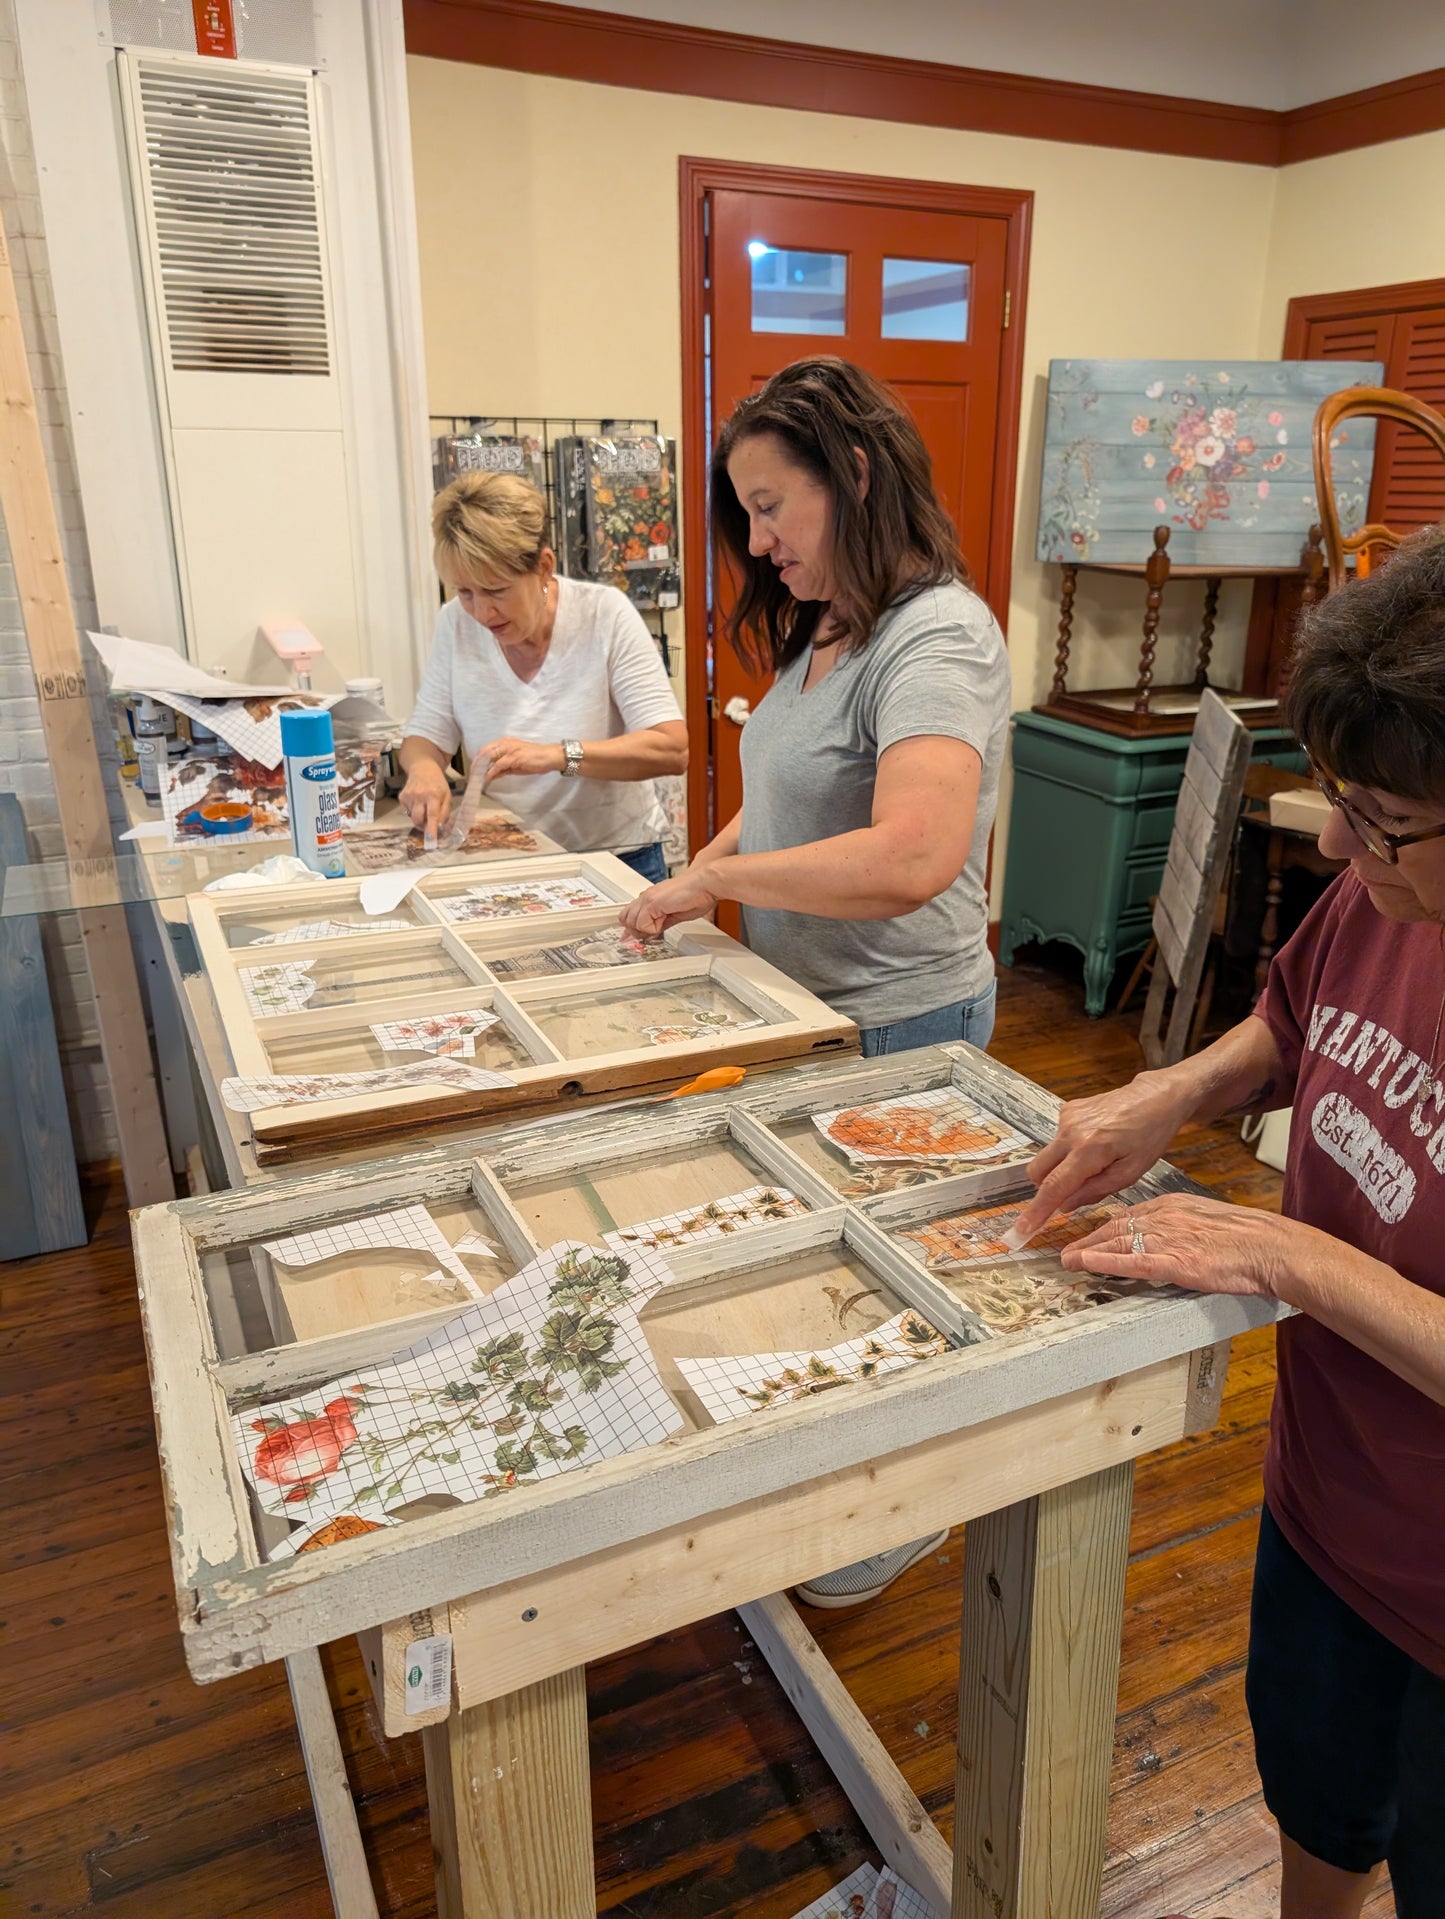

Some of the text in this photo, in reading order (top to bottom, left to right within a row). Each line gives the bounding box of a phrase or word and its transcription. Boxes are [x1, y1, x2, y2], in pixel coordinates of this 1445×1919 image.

[319, 791, 337, 815] glass
[1317, 1102, 1402, 1212] Est. 1671
